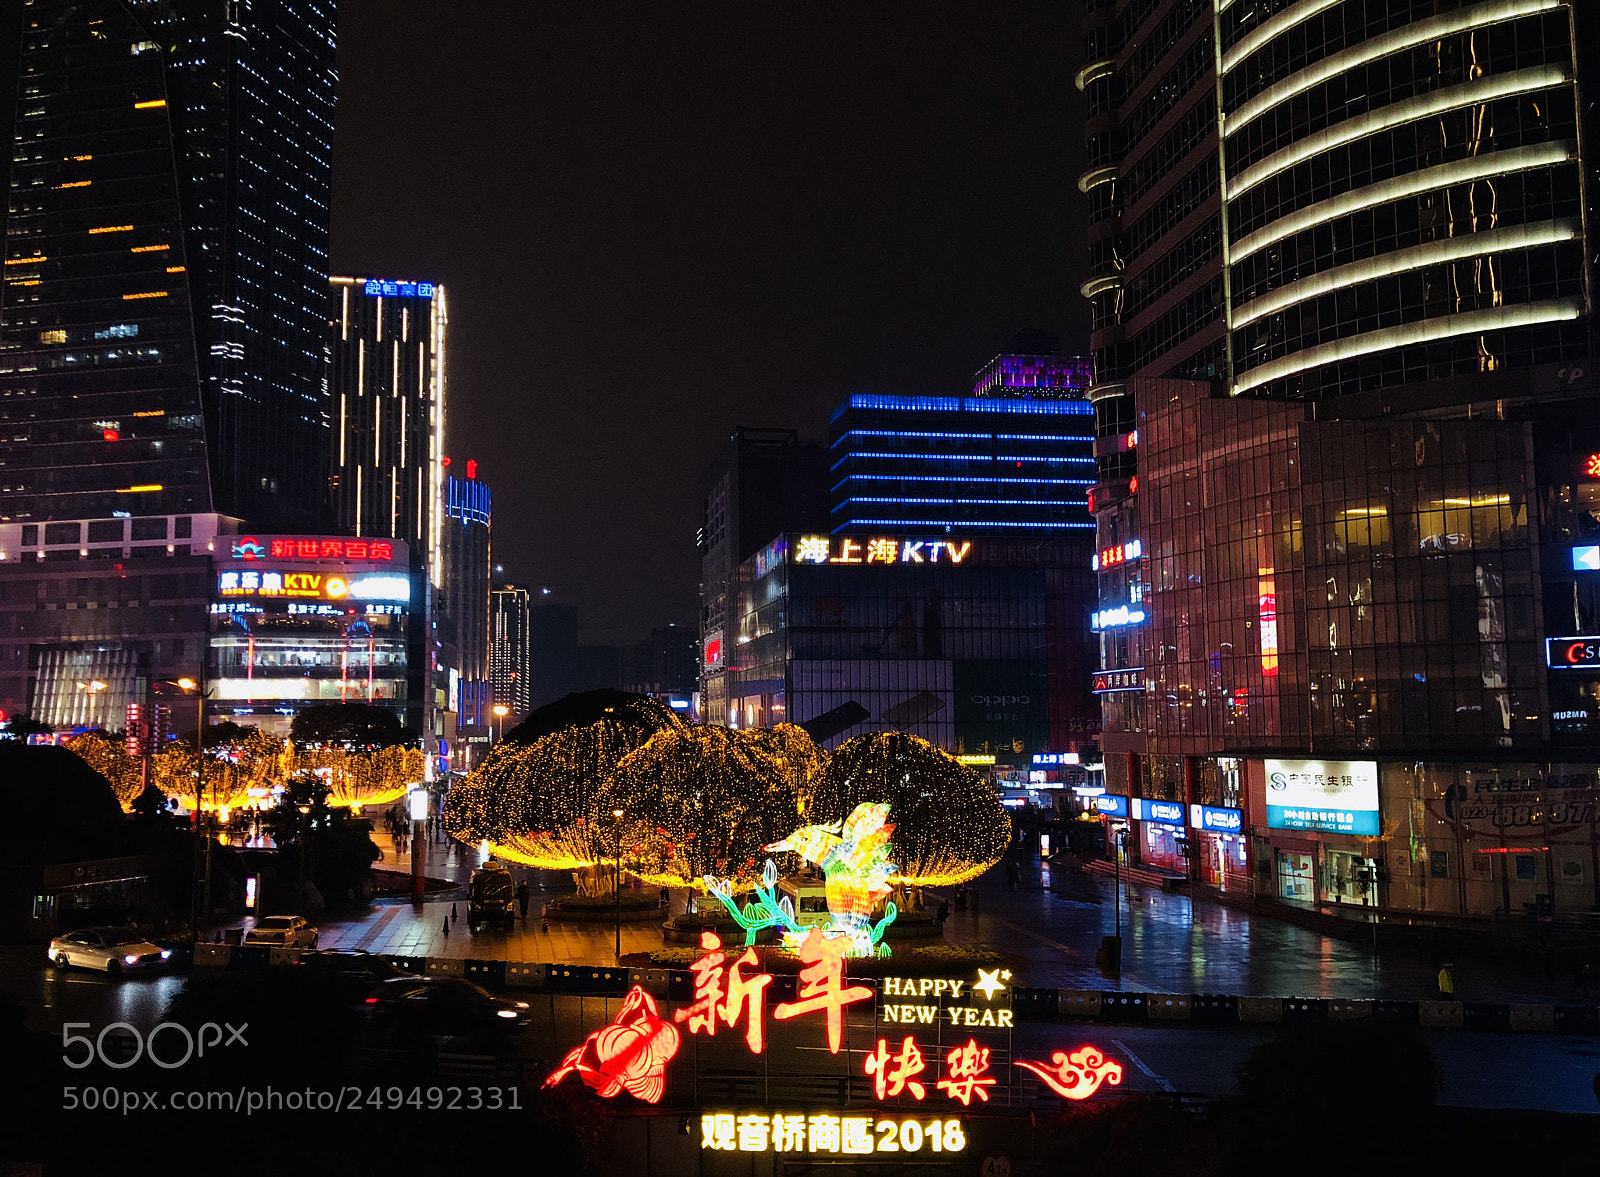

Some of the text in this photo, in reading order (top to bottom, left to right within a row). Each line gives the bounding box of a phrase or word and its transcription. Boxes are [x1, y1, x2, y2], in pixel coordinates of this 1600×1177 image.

[271, 540, 393, 560] 新世界百货
[284, 574, 321, 589] KTV
[674, 928, 873, 1055] 新年
[884, 977, 964, 998] HAPPY
[883, 1004, 1014, 1028] NEW YEAR
